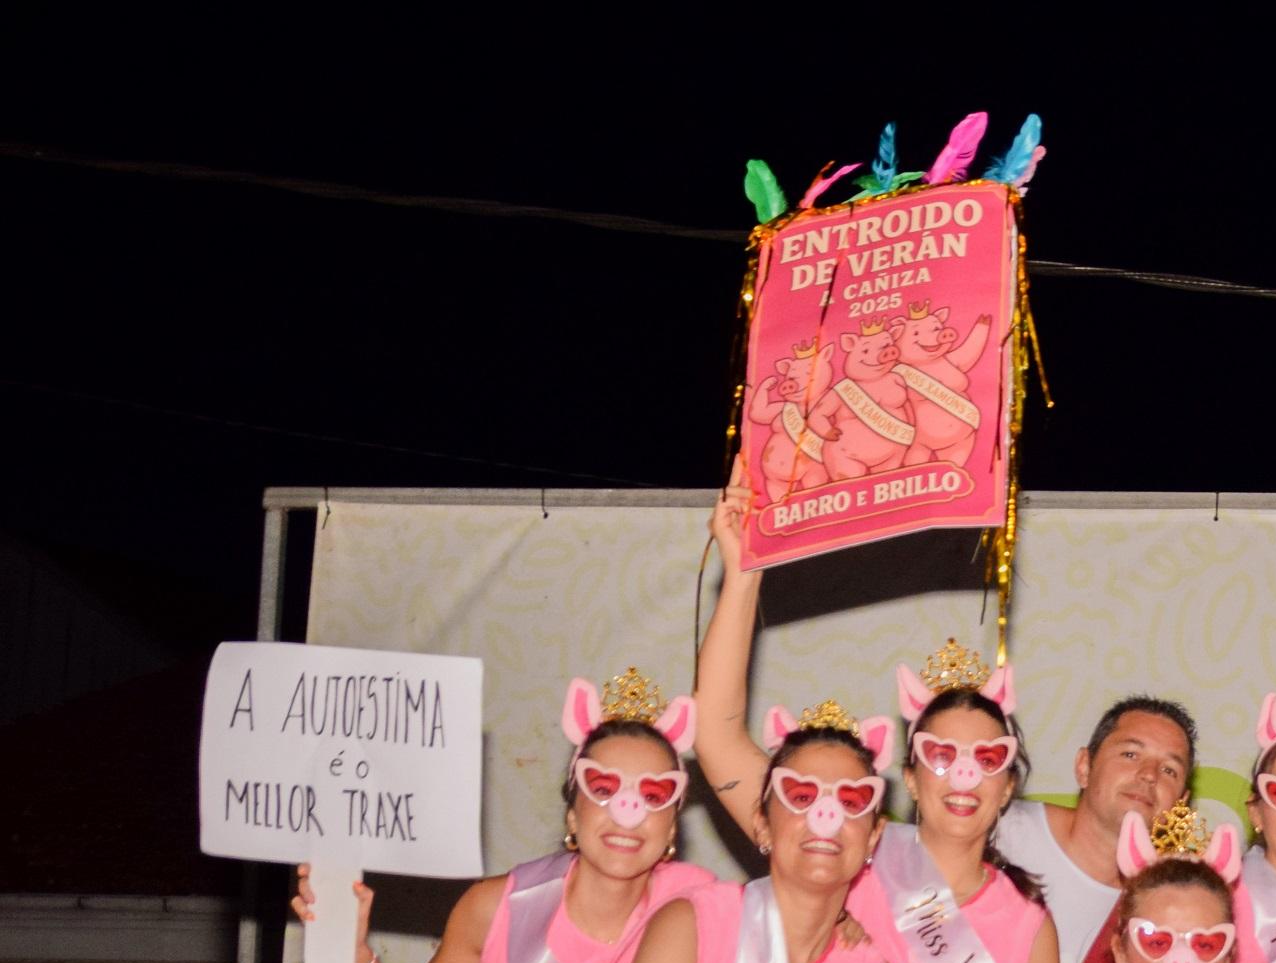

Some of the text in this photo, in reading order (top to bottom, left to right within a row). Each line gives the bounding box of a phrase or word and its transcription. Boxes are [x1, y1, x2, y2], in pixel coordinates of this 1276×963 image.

[780, 199, 983, 264] ENTROIDO
[790, 231, 969, 291] DE VERÁN
[843, 267, 932, 300] CAÑIZA
[848, 293, 903, 318] 2025
[773, 471, 961, 529] BARRO E BRILLO
[229, 667, 446, 749] A AUTOESTIMA
[329, 750, 345, 777] é
[225, 778, 417, 842] MELLOR TRAXE
